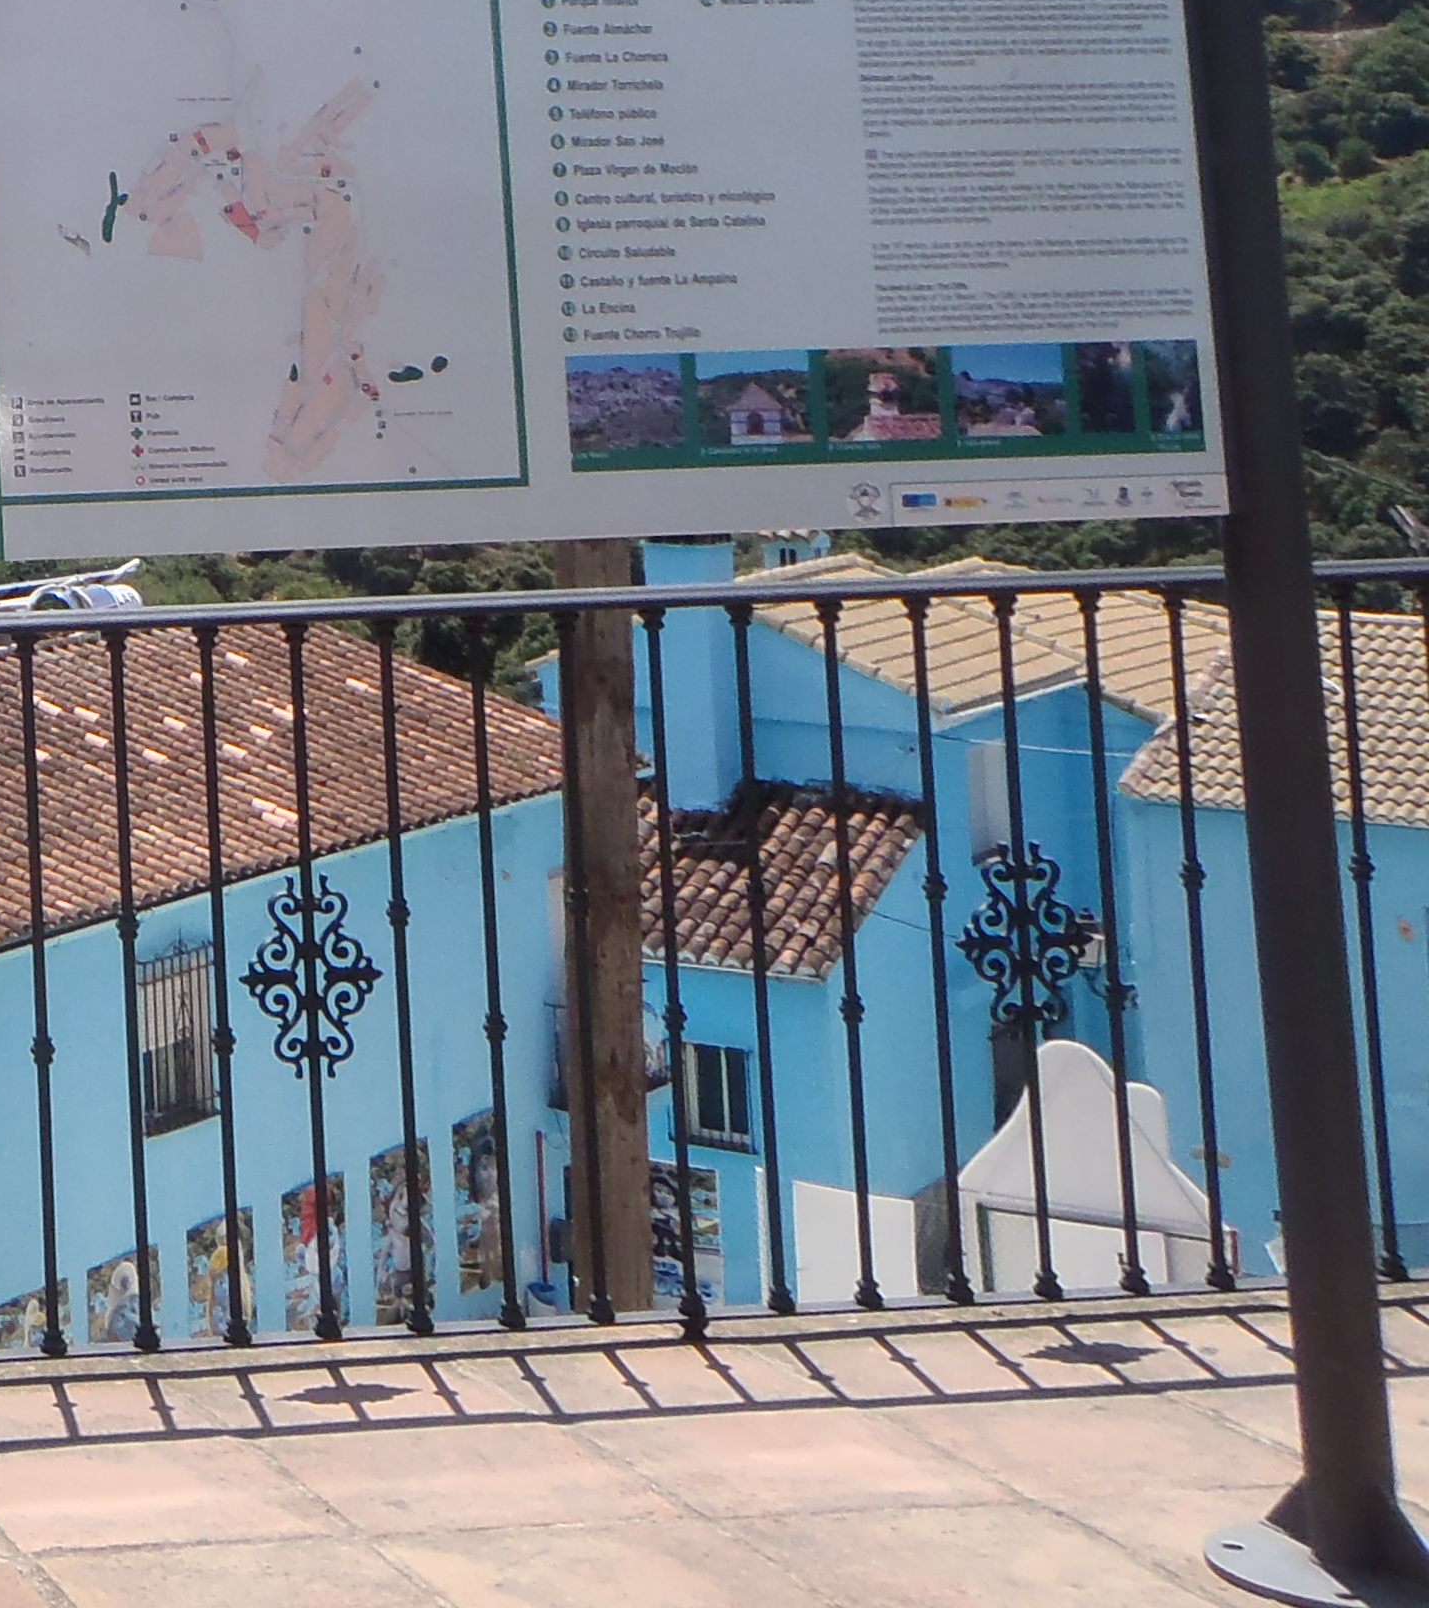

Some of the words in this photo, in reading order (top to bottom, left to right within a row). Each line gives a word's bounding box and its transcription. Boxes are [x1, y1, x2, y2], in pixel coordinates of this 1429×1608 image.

[563, 24, 599, 34] Fuente
[565, 51, 601, 62] Fuente
[605, 51, 618, 62] La
[567, 80, 607, 90] Mirador
[571, 136, 611, 146] Mirador
[616, 135, 635, 146] San
[573, 165, 602, 176] Plaza
[605, 164, 639, 177] Virgen
[643, 164, 656, 175] de
[575, 193, 611, 205] Centro
[672, 218, 685, 228] de
[689, 216, 719, 227] Santa
[723, 215, 766, 226] Catalina
[579, 247, 620, 258] Circuito
[624, 245, 676, 258] Saludable
[580, 276, 624, 287] Castaño
[638, 275, 671, 285] fuente
[675, 274, 688, 284] La
[582, 303, 596, 314] La
[599, 303, 636, 314] Encina
[584, 330, 620, 340] Fuente
[624, 328, 661, 339] Chorro
